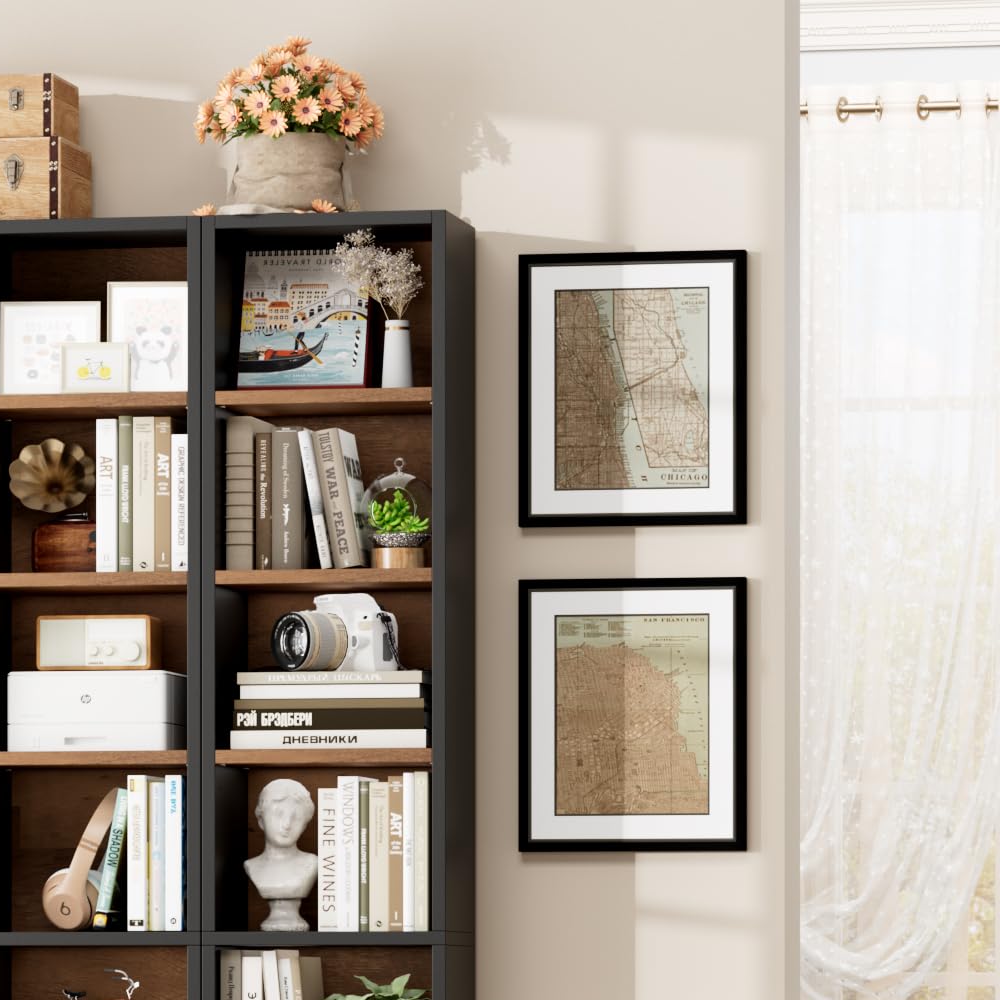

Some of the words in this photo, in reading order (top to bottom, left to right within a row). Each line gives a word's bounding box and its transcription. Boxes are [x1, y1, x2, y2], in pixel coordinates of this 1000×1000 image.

[100, 456, 113, 480] ART
[156, 453, 169, 478] ART
[660, 473, 708, 481] CHICAGO
[259, 482, 268, 519] Revolution
[318, 432, 334, 462] TOLSTOY
[326, 467, 339, 500] WAR
[333, 512, 349, 555] PEACE
[236, 710, 257, 727] РЭЙ
[261, 712, 313, 727] БРЭДБЕРИ
[282, 736, 358, 745] ДНЕВНИКИ
[322, 808, 335, 847] FINE
[341, 781, 354, 845] WINDOWS
[390, 812, 402, 838] ART
[106, 828, 123, 867] SHADOW
[322, 855, 335, 912] WINES
